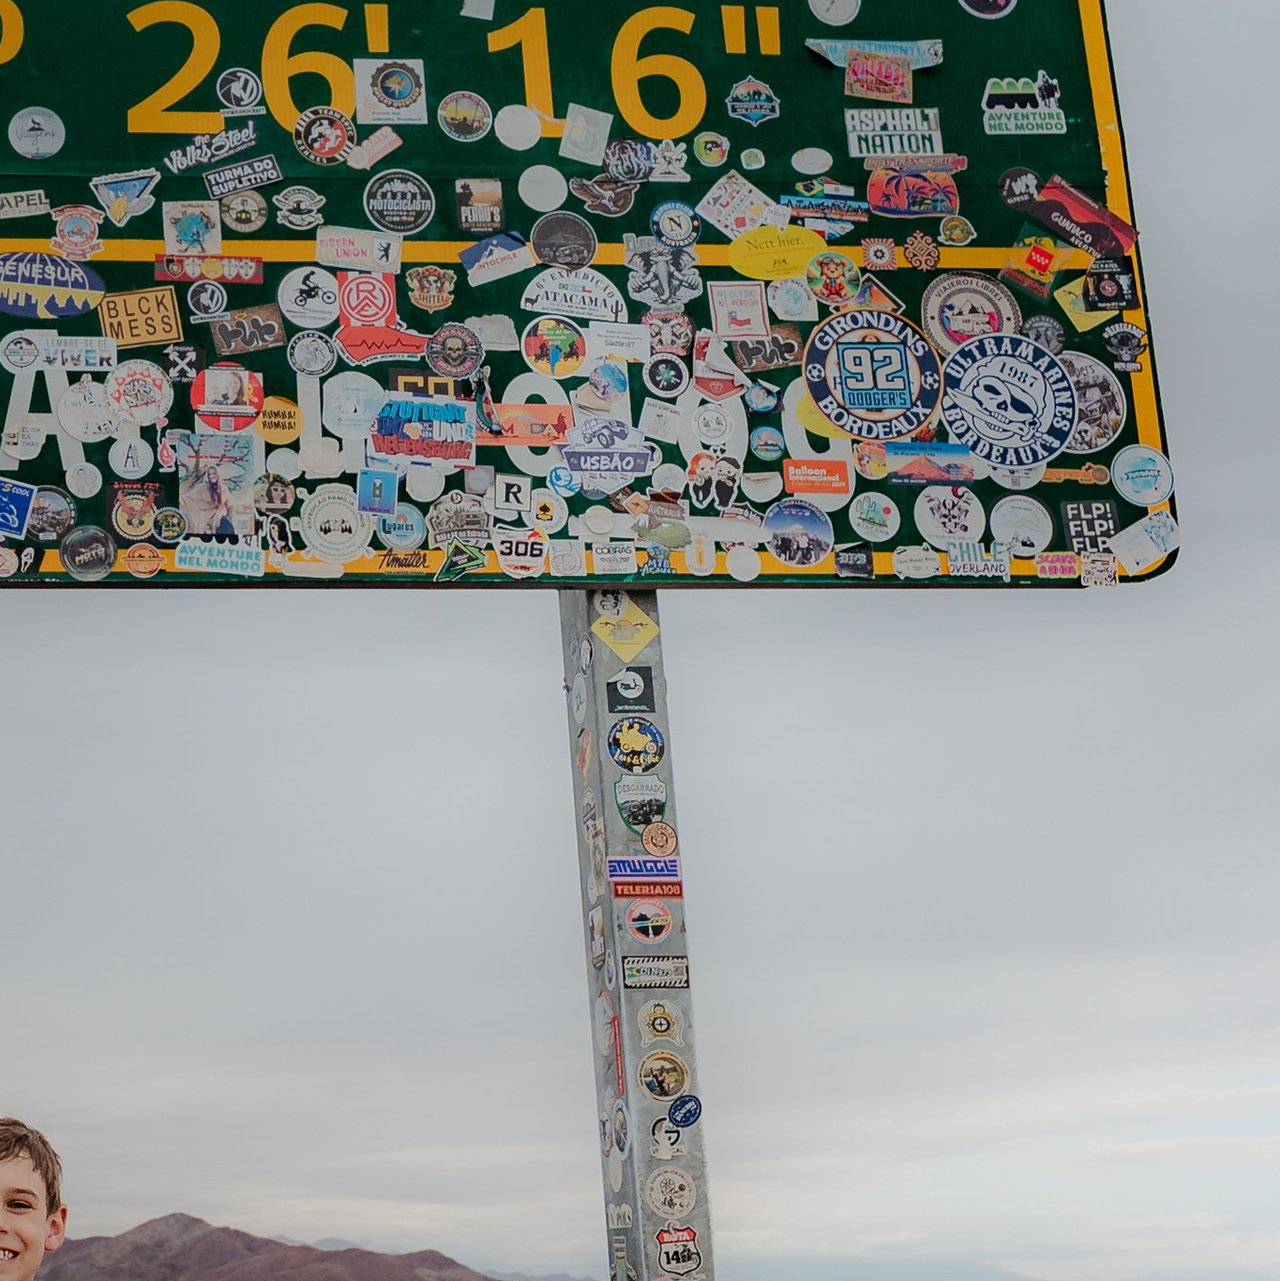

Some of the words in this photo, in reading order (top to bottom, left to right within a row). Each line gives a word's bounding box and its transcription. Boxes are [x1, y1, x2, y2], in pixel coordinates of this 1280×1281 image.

[845, 109, 937, 132] ASPHALT
[988, 112, 1062, 121] AVVENTURE
[989, 122, 1012, 131] NEL
[1015, 122, 1063, 132] MONDO
[16, 129, 57, 145] Viagens
[211, 120, 257, 155] Steel
[857, 132, 934, 154] NATION
[208, 166, 253, 185] TURMA
[254, 159, 274, 171] DO
[211, 170, 278, 197] SUPLETIVO
[369, 199, 431, 211] MOTOCICLISTA
[661, 231, 697, 247] AUSTRALIA
[745, 236, 773, 251] Nett
[776, 234, 804, 247] hier.
[336, 249, 368, 259] UNION
[477, 252, 518, 272] INTOCHILE
[548, 269, 615, 298] EXPEDIÇÃO
[106, 293, 169, 318] BLCK
[541, 290, 608, 308] ATACAMA
[109, 314, 173, 340] MESS
[815, 311, 929, 357] GIRONDINS
[96, 339, 108, 348] DE
[844, 347, 903, 390] 92
[998, 361, 1038, 387] 1987
[946, 336, 1070, 431] ULTRAMARINES
[262, 411, 296, 420] RUMBA!
[378, 400, 467, 423] STUTTGART
[817, 396, 929, 440] BORDEAUX
[262, 421, 296, 430] RUMBA!
[946, 408, 1050, 465] BORDEAUX
[581, 454, 634, 471] USBÃO
[789, 467, 826, 476] Balloon
[12, 486, 30, 497] COOL
[504, 482, 523, 504] R
[1067, 503, 1111, 519] FLP!
[381, 518, 415, 534] Lugares
[1070, 520, 1115, 535] FLP!
[179, 545, 262, 561] AVVENTURE
[500, 540, 543, 557] 306
[595, 546, 632, 554] COBRAS
[949, 541, 1004, 562] CHILE
[178, 556, 204, 567] NEL
[206, 559, 261, 572] MONDO
[949, 563, 1006, 574] OVERLAND
[618, 784, 664, 795] DESGARRADO
[616, 885, 680, 896] TELERIA108
